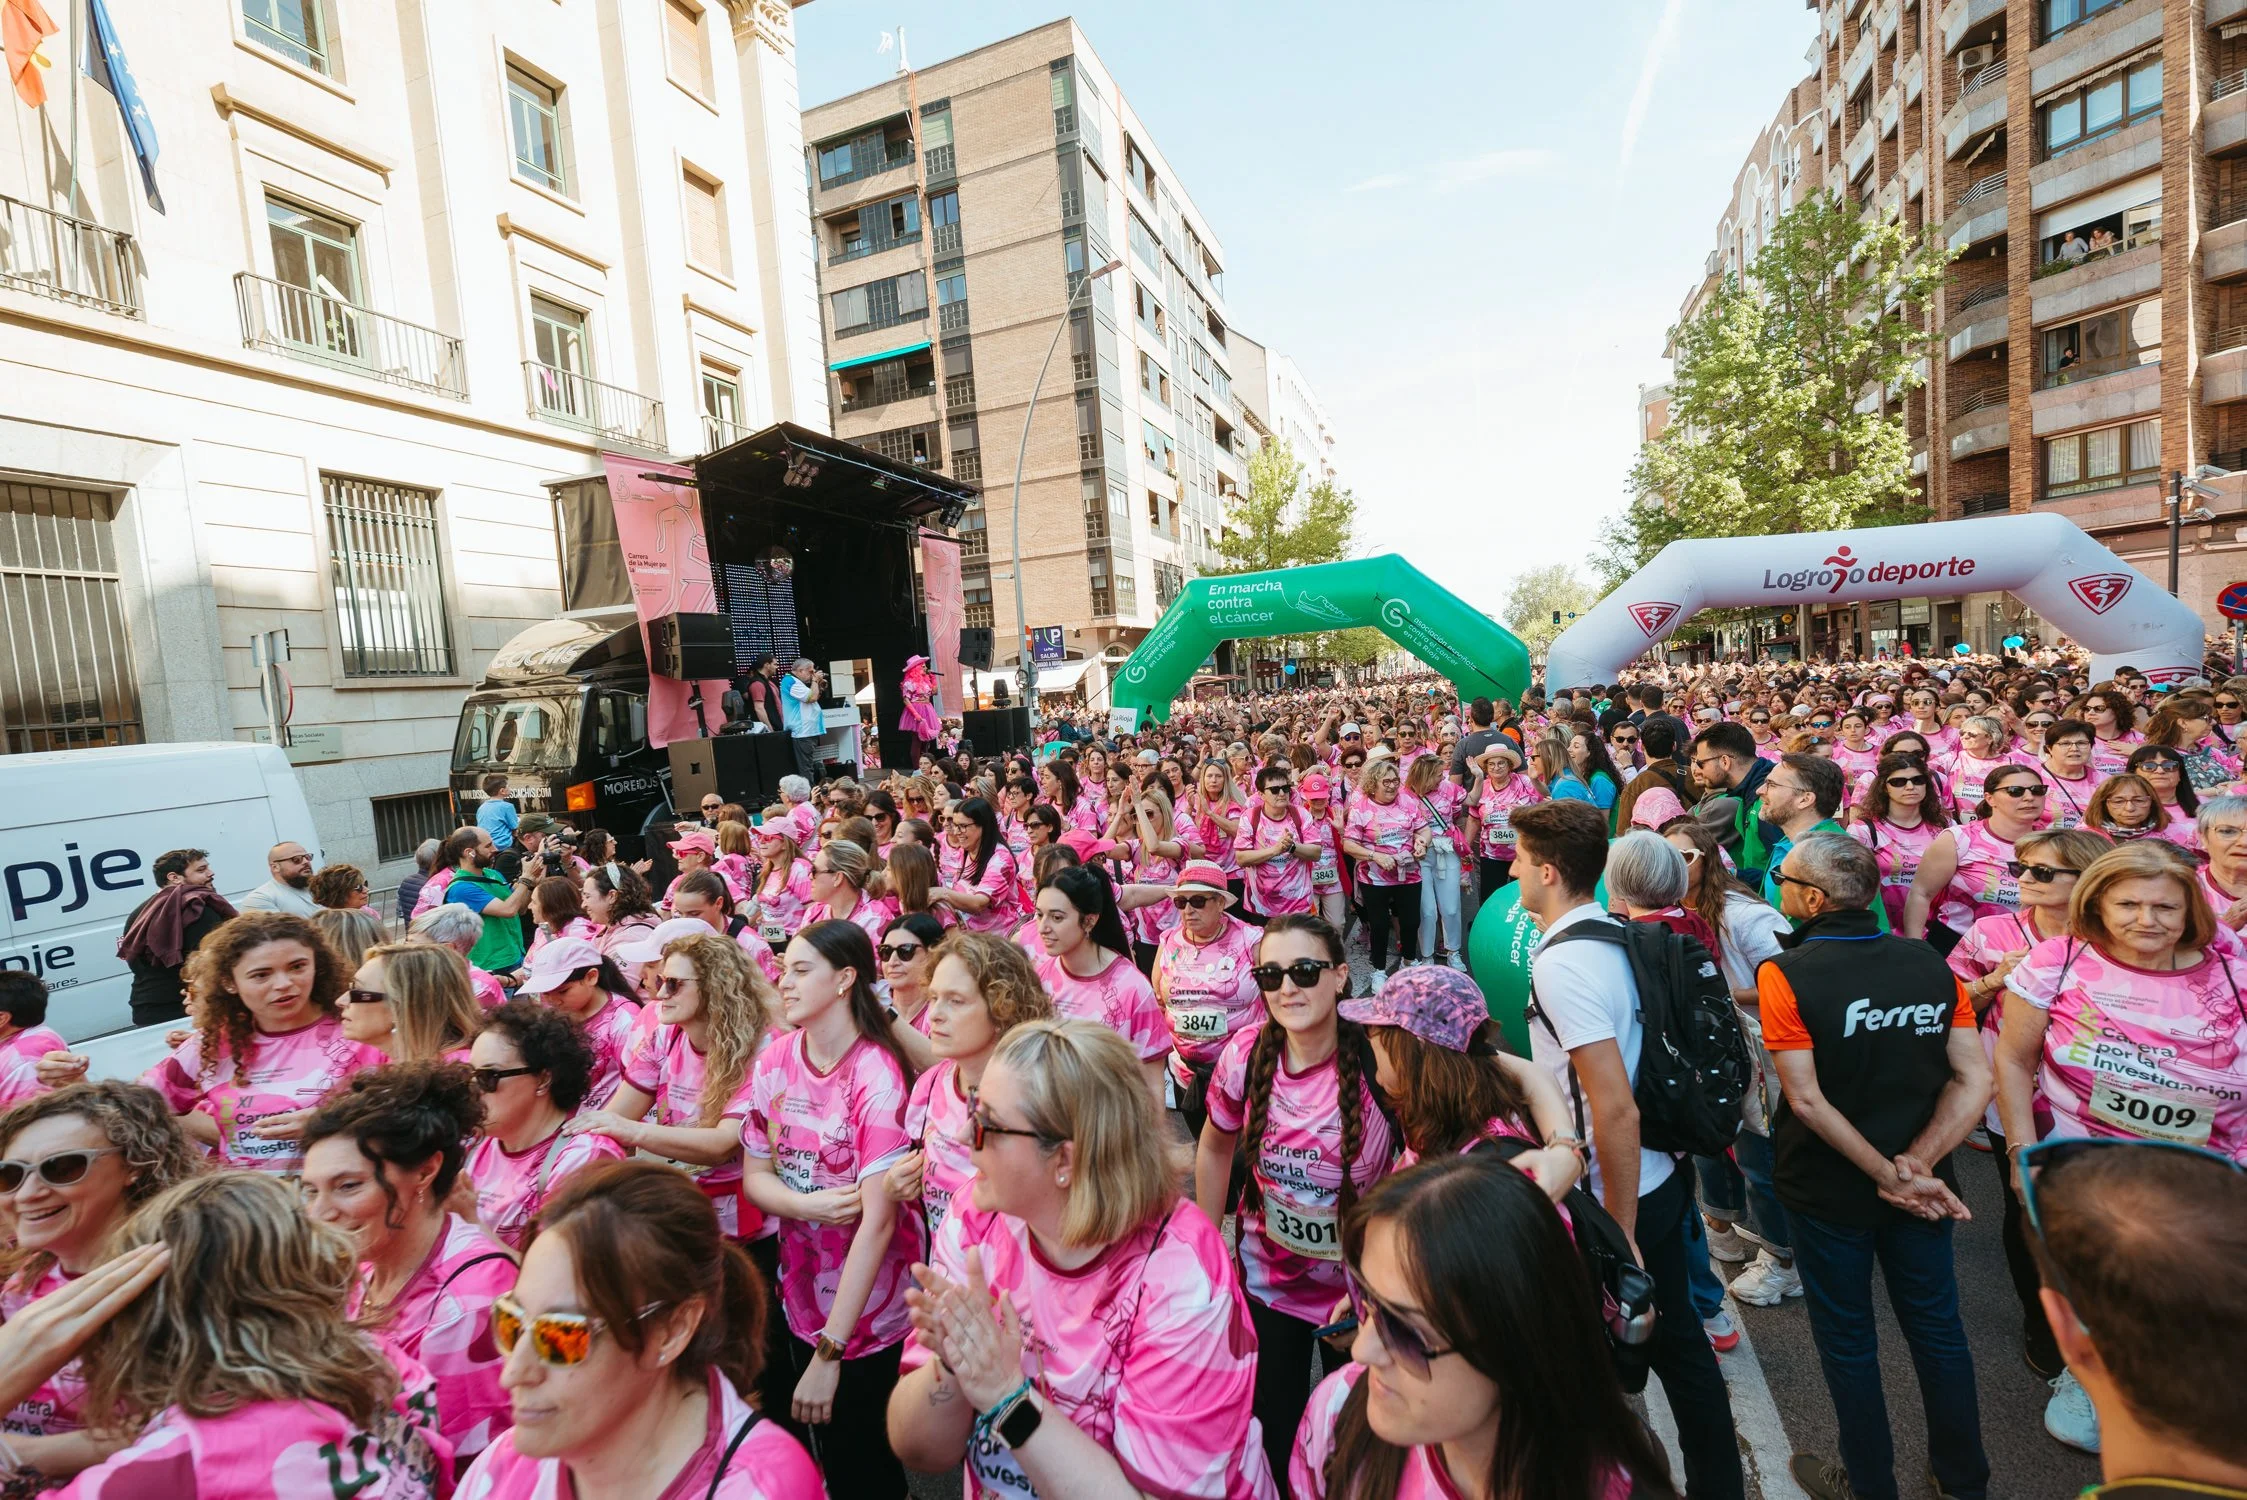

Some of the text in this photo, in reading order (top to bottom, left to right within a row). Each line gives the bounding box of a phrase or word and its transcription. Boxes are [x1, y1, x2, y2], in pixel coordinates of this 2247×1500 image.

[1867, 556, 1976, 585] deporte
[1209, 580, 1282, 596] En marcha
[1208, 596, 1252, 609] contra
[1209, 611, 1274, 624] el cáncer
[1051, 629, 1061, 643] P
[1161, 640, 1176, 655] Rioja
[1403, 630, 1440, 661] en La Rioja
[1119, 715, 1133, 723] Rioja
[1493, 830, 1514, 839] 3846
[4, 842, 144, 922] pje
[1315, 870, 1334, 880] 3843
[1997, 888, 2019, 899] por
[1510, 912, 1528, 967] cáncer
[1169, 986, 1209, 996] Carrera
[1182, 1015, 1217, 1031] 3847
[1843, 998, 1946, 1038] Ferrer
[2096, 1043, 2155, 1069] por la
[237, 1095, 254, 1109] XI
[2106, 1090, 2196, 1129] 3009
[779, 1124, 791, 1139] XI
[1263, 1138, 1320, 1160] Carrera
[798, 1164, 810, 1179] la
[1263, 1158, 1304, 1178] por la
[1276, 1209, 1337, 1244] 3301
